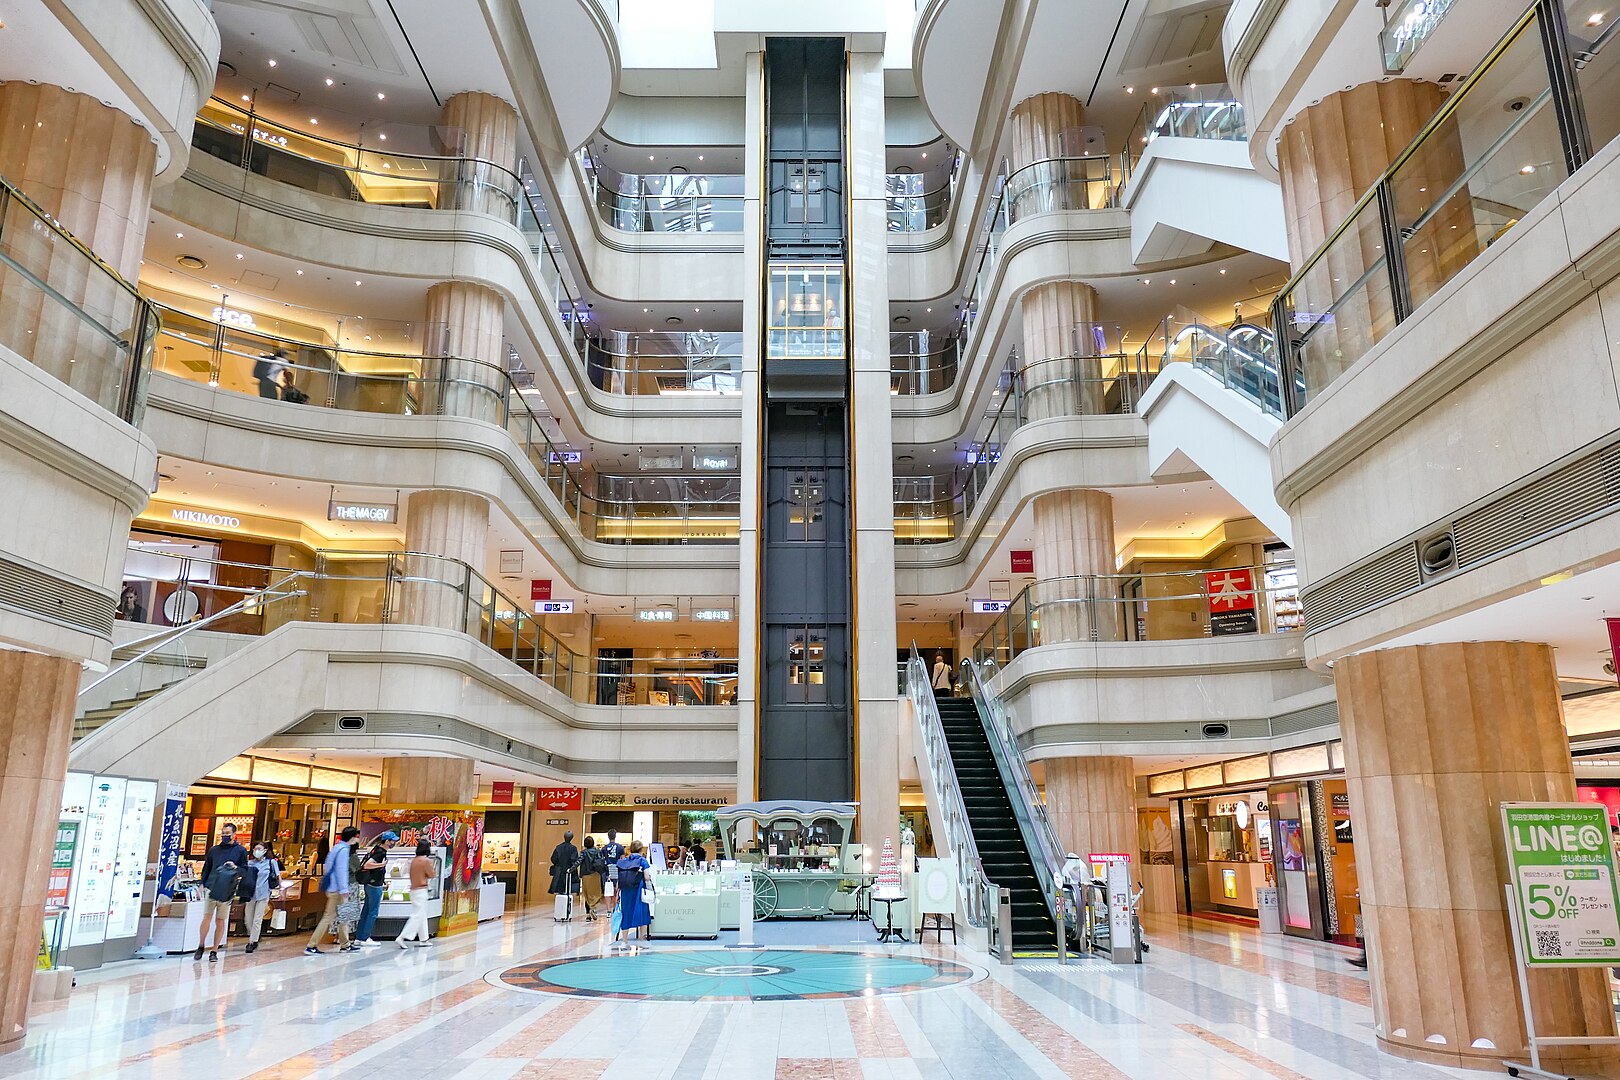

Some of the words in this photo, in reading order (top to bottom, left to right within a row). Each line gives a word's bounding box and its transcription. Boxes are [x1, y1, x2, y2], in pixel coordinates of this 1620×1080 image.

[172, 509, 240, 528] MIKIMOTO
[1211, 572, 1249, 608] 本
[540, 790, 578, 799] レストラン
[633, 796, 669, 805] Garden
[672, 796, 728, 805] Restaurant
[1511, 813, 1599, 821] 羽田空港国内線ターミナルショップ
[1512, 825, 1604, 851] LINE@
[1560, 854, 1607, 862] はじめました!
[1528, 884, 1577, 919] 5%
[1557, 908, 1579, 919] OFF
